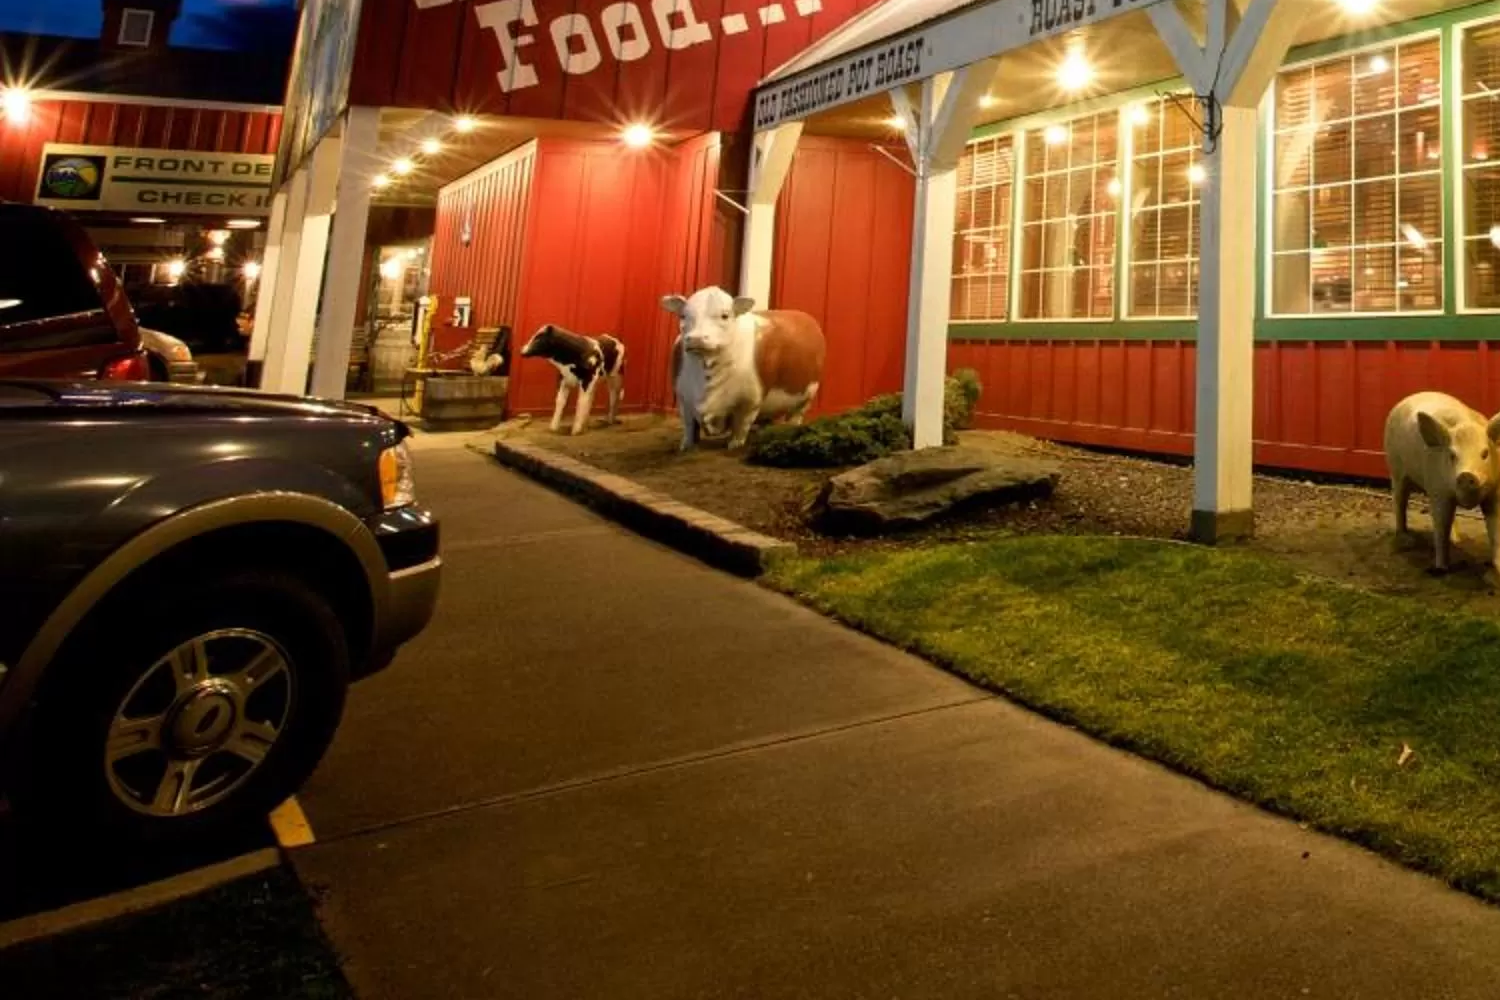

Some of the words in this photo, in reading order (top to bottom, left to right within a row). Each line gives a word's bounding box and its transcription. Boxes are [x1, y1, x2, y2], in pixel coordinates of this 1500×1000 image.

[779, 67, 845, 119] FASHIONED
[847, 55, 874, 96] POT
[875, 36, 925, 87] ROAST
[113, 155, 225, 174] FRONT
[137, 188, 247, 208] CHECK
